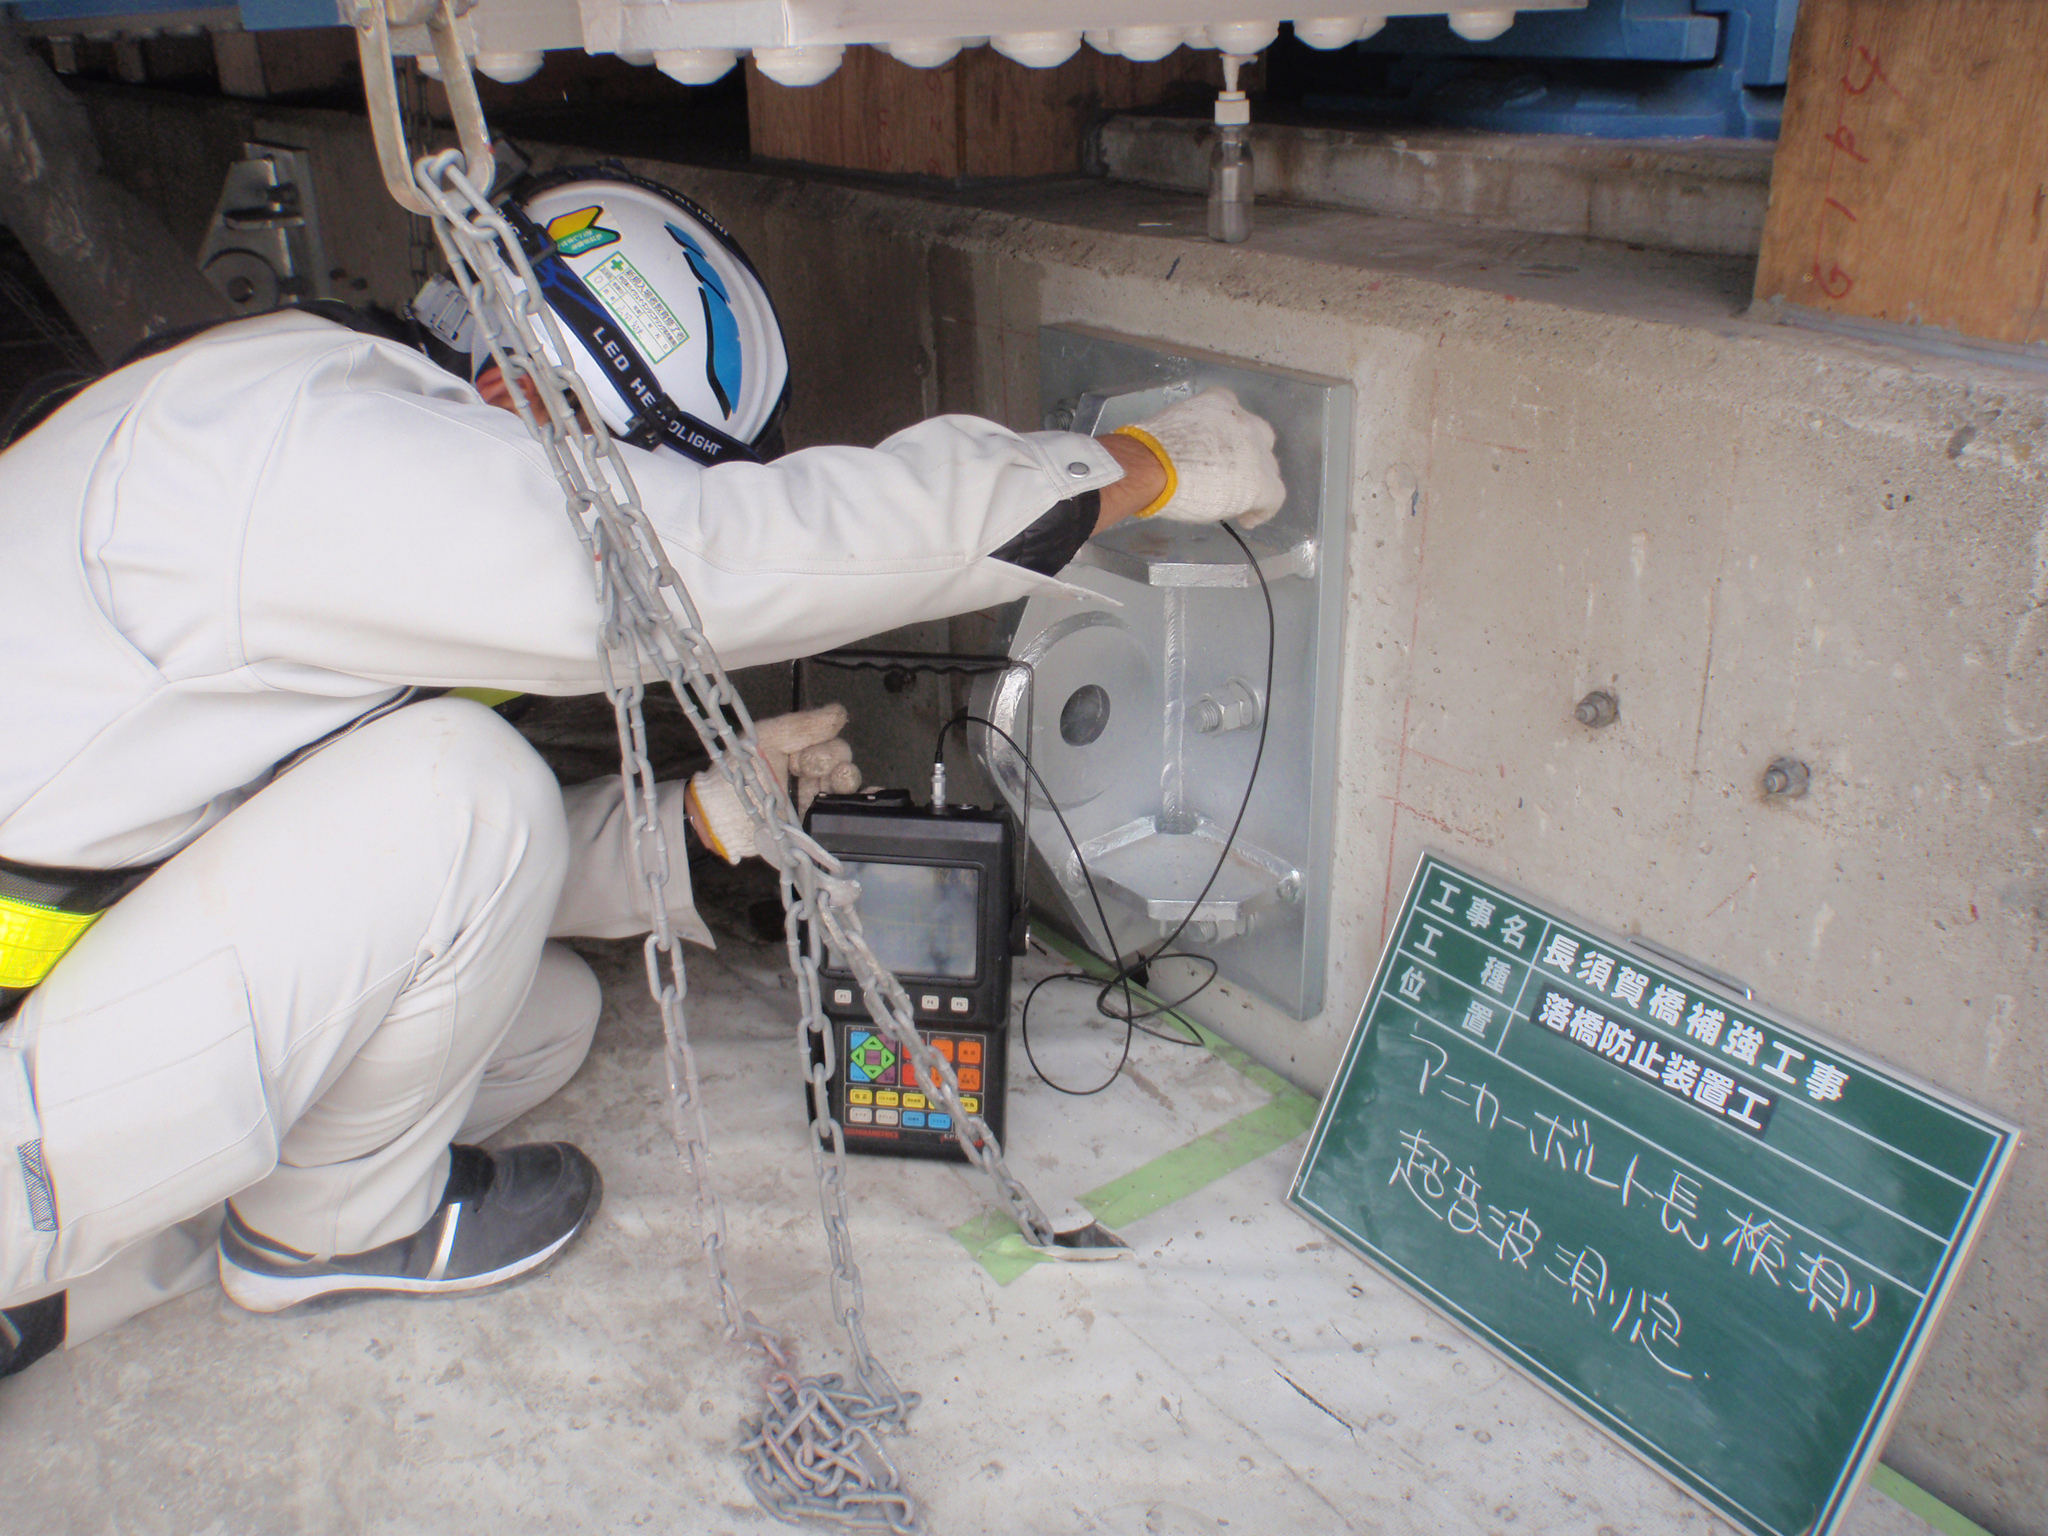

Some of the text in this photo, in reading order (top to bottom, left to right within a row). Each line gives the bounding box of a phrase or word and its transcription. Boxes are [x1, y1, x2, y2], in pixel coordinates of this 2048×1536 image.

[592, 326, 631, 372] LED
[630, 377, 722, 455] HEDLIGHT
[1430, 880, 1528, 950] 工事名
[1537, 992, 1770, 1130] 落橋防止装置工
[1543, 934, 1849, 1101] 長須賀橋補強工事
